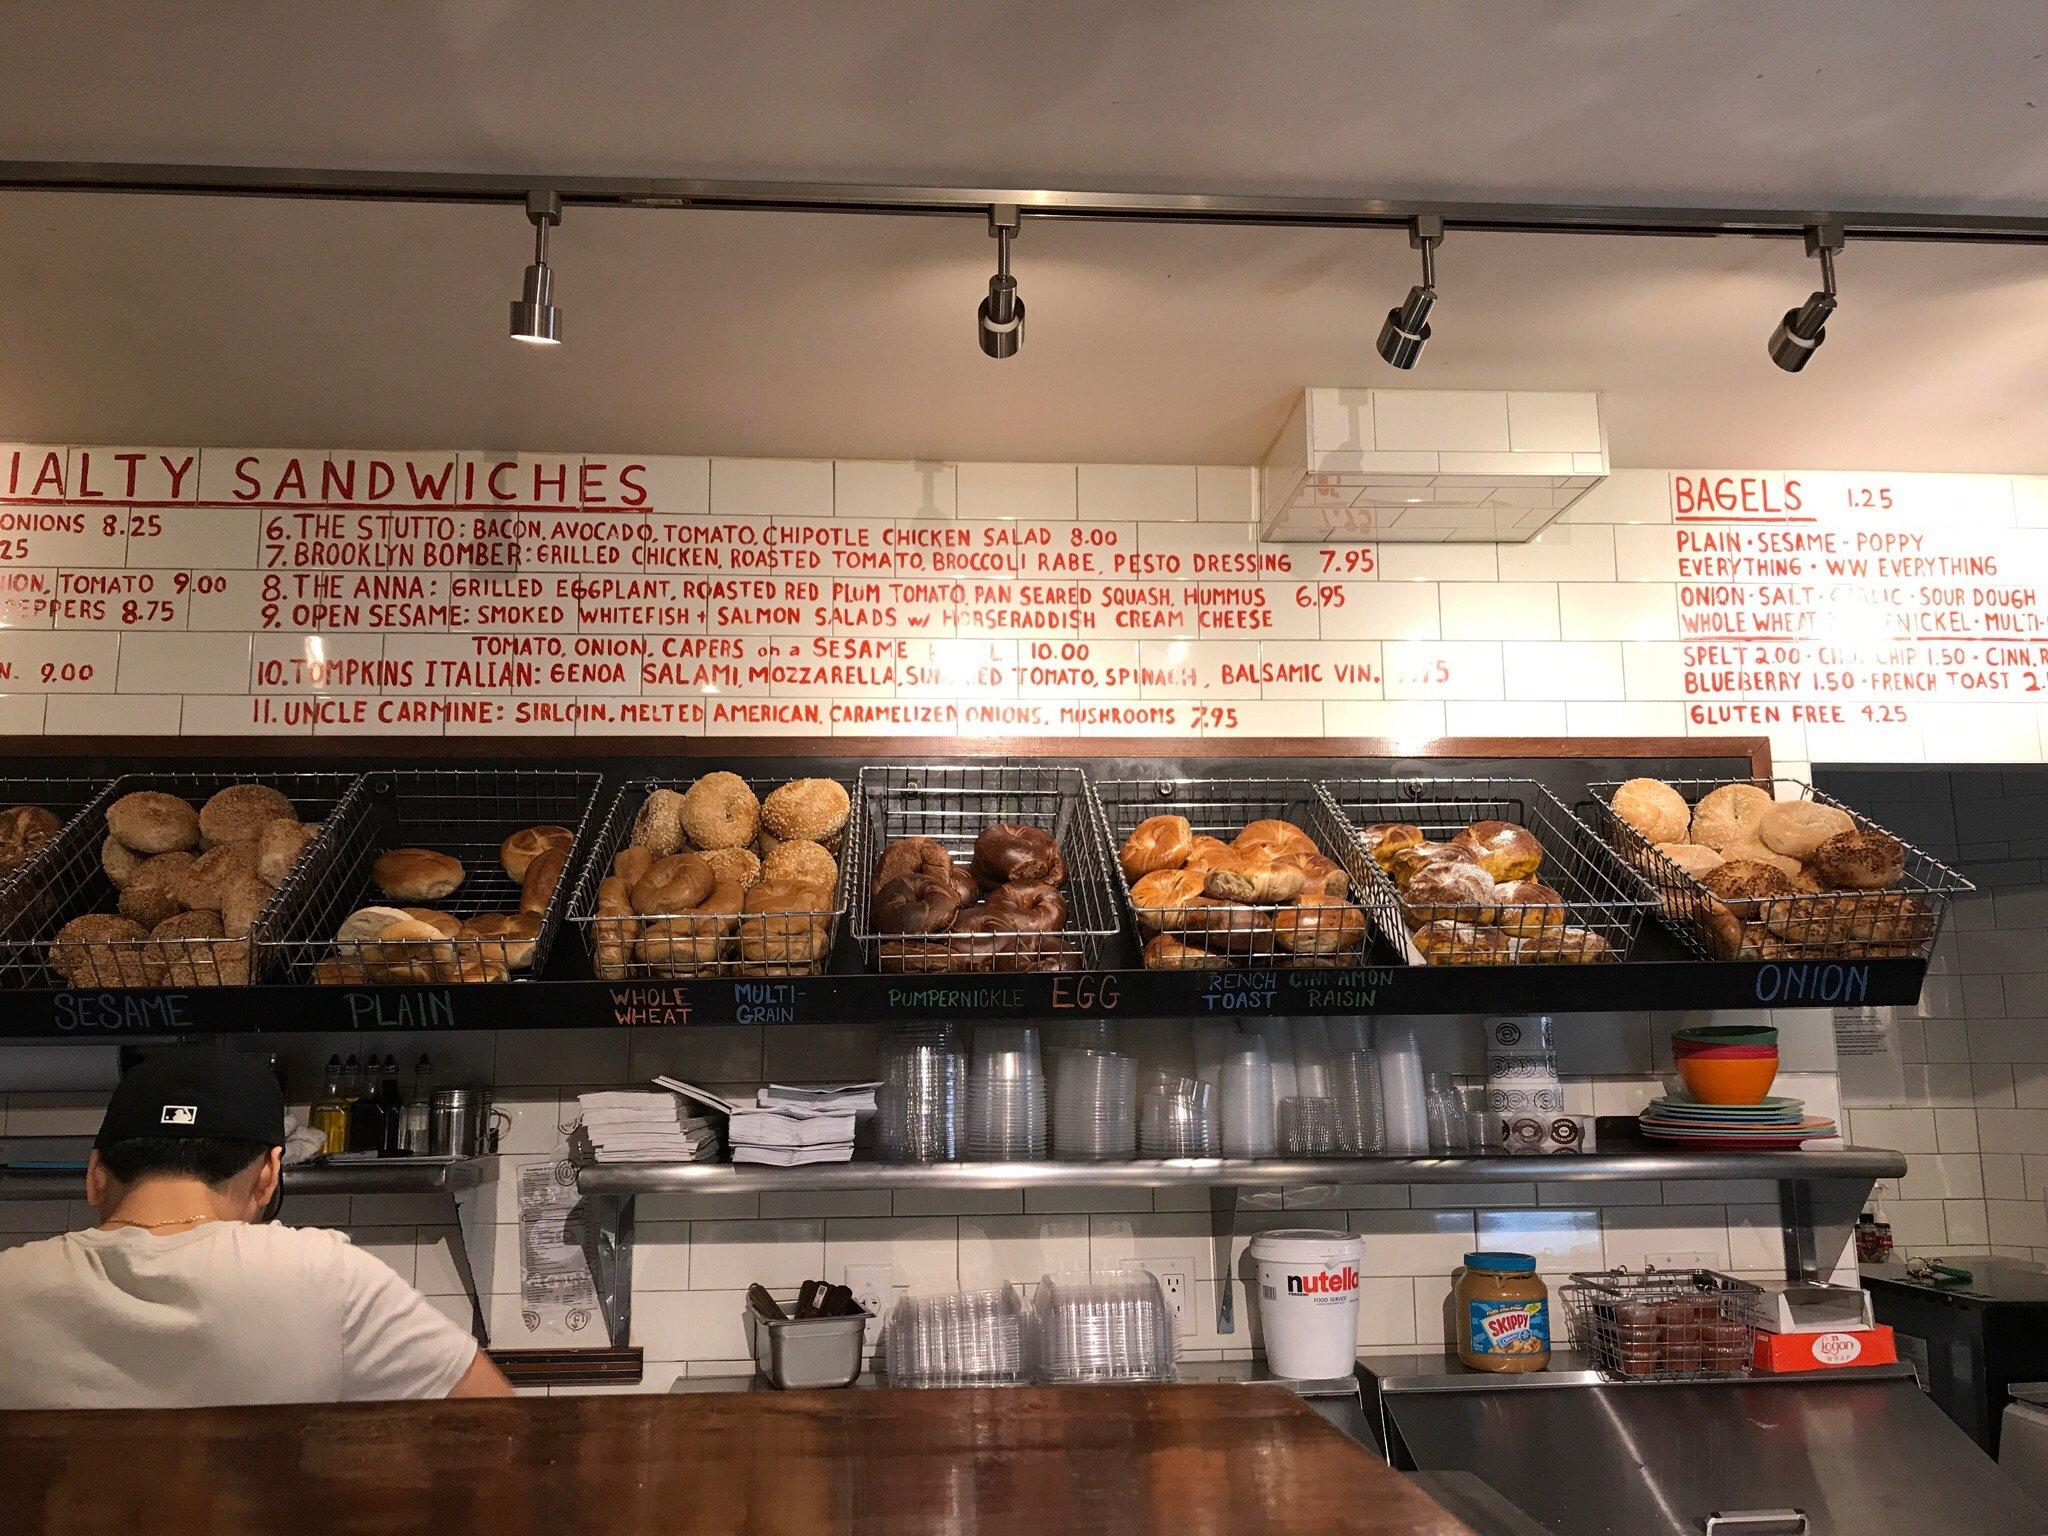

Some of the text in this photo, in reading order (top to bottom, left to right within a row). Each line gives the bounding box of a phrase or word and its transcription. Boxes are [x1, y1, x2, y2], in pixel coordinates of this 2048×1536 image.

[232, 456, 648, 504] SANDWICHES
[1676, 476, 1893, 513] BAGELS 1.25
[1, 514, 162, 537] ONIONS 8.25
[293, 513, 345, 540] THE
[357, 515, 465, 540] STUTTO:
[762, 525, 870, 548] CHIPOTLE
[883, 527, 971, 549] CHICKEN
[984, 527, 1051, 547] SALAD
[1070, 527, 1118, 547] 8.00
[1677, 530, 1924, 553] PLAIN SESAME POPPY
[294, 542, 414, 567] BROOKLYN
[423, 543, 531, 567] BOMBER:
[537, 545, 620, 566] GRILLED
[731, 549, 821, 569] ROASTED
[933, 552, 1026, 572] BROCCOLI
[1114, 554, 1180, 574] PESTO
[1193, 553, 1292, 573] DRESSING
[1319, 549, 1374, 574] 7.95
[1679, 556, 1997, 577] EVERYTHING WW EVERYTHING
[60, 573, 154, 595] TOMATO
[174, 573, 227, 595] 9.00
[293, 573, 345, 599] THE
[353, 575, 437, 600] ANNA:
[452, 578, 543, 598] GRILLED
[683, 580, 776, 600] ROASTED
[785, 582, 819, 600] RED
[833, 583, 880, 603] PLUM
[974, 586, 1011, 605] PAN
[1020, 587, 1092, 606] SEARED
[1184, 588, 1266, 607] HUMMUS
[1296, 586, 1346, 608] 6.95
[1681, 587, 1744, 607] ONION
[1760, 586, 1814, 606] SALT
[1920, 587, 1964, 606] SOUR
[1973, 587, 2036, 609] DOUGH
[122, 600, 174, 624] 8.75
[292, 604, 360, 628] OPEN
[369, 604, 470, 628] SESAME:
[477, 605, 564, 625] SMOKED
[580, 606, 689, 625] WHITEFISH
[717, 606, 800, 626] SALMON
[815, 607, 897, 627] SALADS
[908, 613, 930, 628] w/
[943, 609, 1096, 629] HORSERADDISH
[1116, 611, 1184, 628] CREAM
[1200, 610, 1273, 629] CHEESE
[1682, 612, 1745, 633] WHOLE
[1752, 611, 1816, 633] WHEAT
[1985, 612, 2048, 632] MULTI-
[662, 638, 744, 658] CAPERS
[757, 646, 780, 657] on
[789, 645, 801, 657] a
[813, 637, 908, 659] SESAME
[1031, 642, 1089, 661] 10.00
[1684, 647, 1748, 667] SPELT
[1755, 647, 1800, 665] 2.00
[1928, 648, 1965, 666] 1.50
[40, 663, 93, 683] 9.00
[290, 658, 413, 688] TOMPKINS
[425, 660, 541, 687] ITALIAN:
[550, 664, 625, 683] GENOA
[1221, 664, 1322, 685] BALSAMIC
[1334, 665, 1380, 683] VIN.
[1685, 671, 1800, 694] BLUEBERRY
[1813, 671, 1854, 691] 1.50
[1871, 672, 1937, 691] FRENCH
[1946, 671, 2009, 690] TOAST
[284, 700, 368, 725] UNCLE
[378, 701, 504, 724] CARMINE:
[620, 703, 704, 723] MELTED
[830, 705, 957, 723] CARAMELIZED
[1060, 707, 1176, 724] MUSHROOMS
[1191, 707, 1238, 728] 7.95
[1691, 705, 1908, 724] GLUTEN FREE 4.25
[734, 984, 806, 1004] MULTI-
[1052, 975, 1121, 1010] EGG
[1756, 965, 1868, 1001] ONION
[609, 987, 692, 1007] WHOLE
[889, 989, 1024, 1007] PUMPERNICKLE
[1202, 991, 1277, 1010] TOAST
[1308, 989, 1376, 1007] RAISIN
[54, 994, 194, 1030] SESAME
[345, 990, 455, 1028] PLAIN
[614, 1008, 693, 1025] WHEAT
[736, 1005, 794, 1024] GRAIN
[1488, 1314, 1528, 1337] SKIPPY
